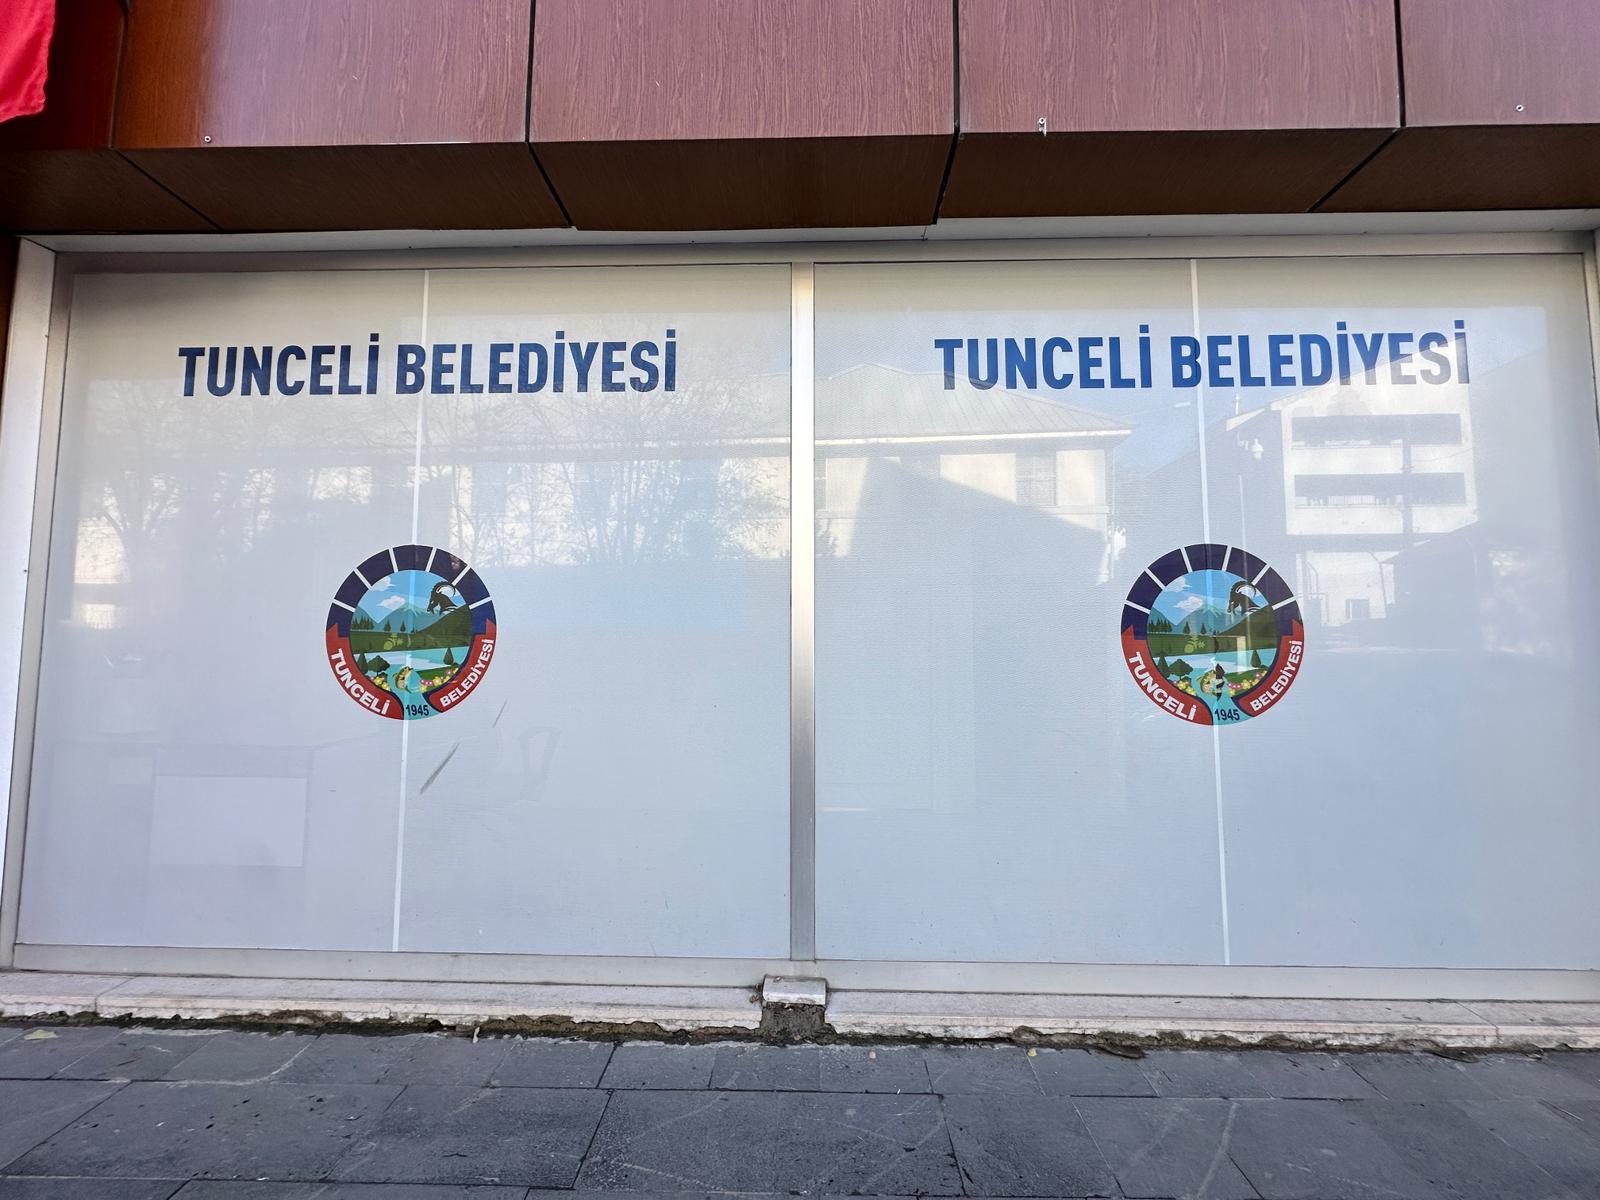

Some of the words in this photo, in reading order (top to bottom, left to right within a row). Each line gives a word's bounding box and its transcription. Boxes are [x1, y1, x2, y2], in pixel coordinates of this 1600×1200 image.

[178, 333, 380, 396] TUNCELİ
[395, 329, 676, 395] BELEDİYESİ
[933, 324, 1153, 390] TUNCELİ
[1170, 319, 1470, 388] BELEDİYESİ
[330, 648, 391, 715] TUNCELİ
[439, 638, 494, 707] BELEDİYESİ
[405, 704, 430, 716] 1945
[1128, 651, 1197, 721] TUNCELİ
[1250, 639, 1303, 711] BELEDİYESİ
[1214, 708, 1240, 721] 1945
